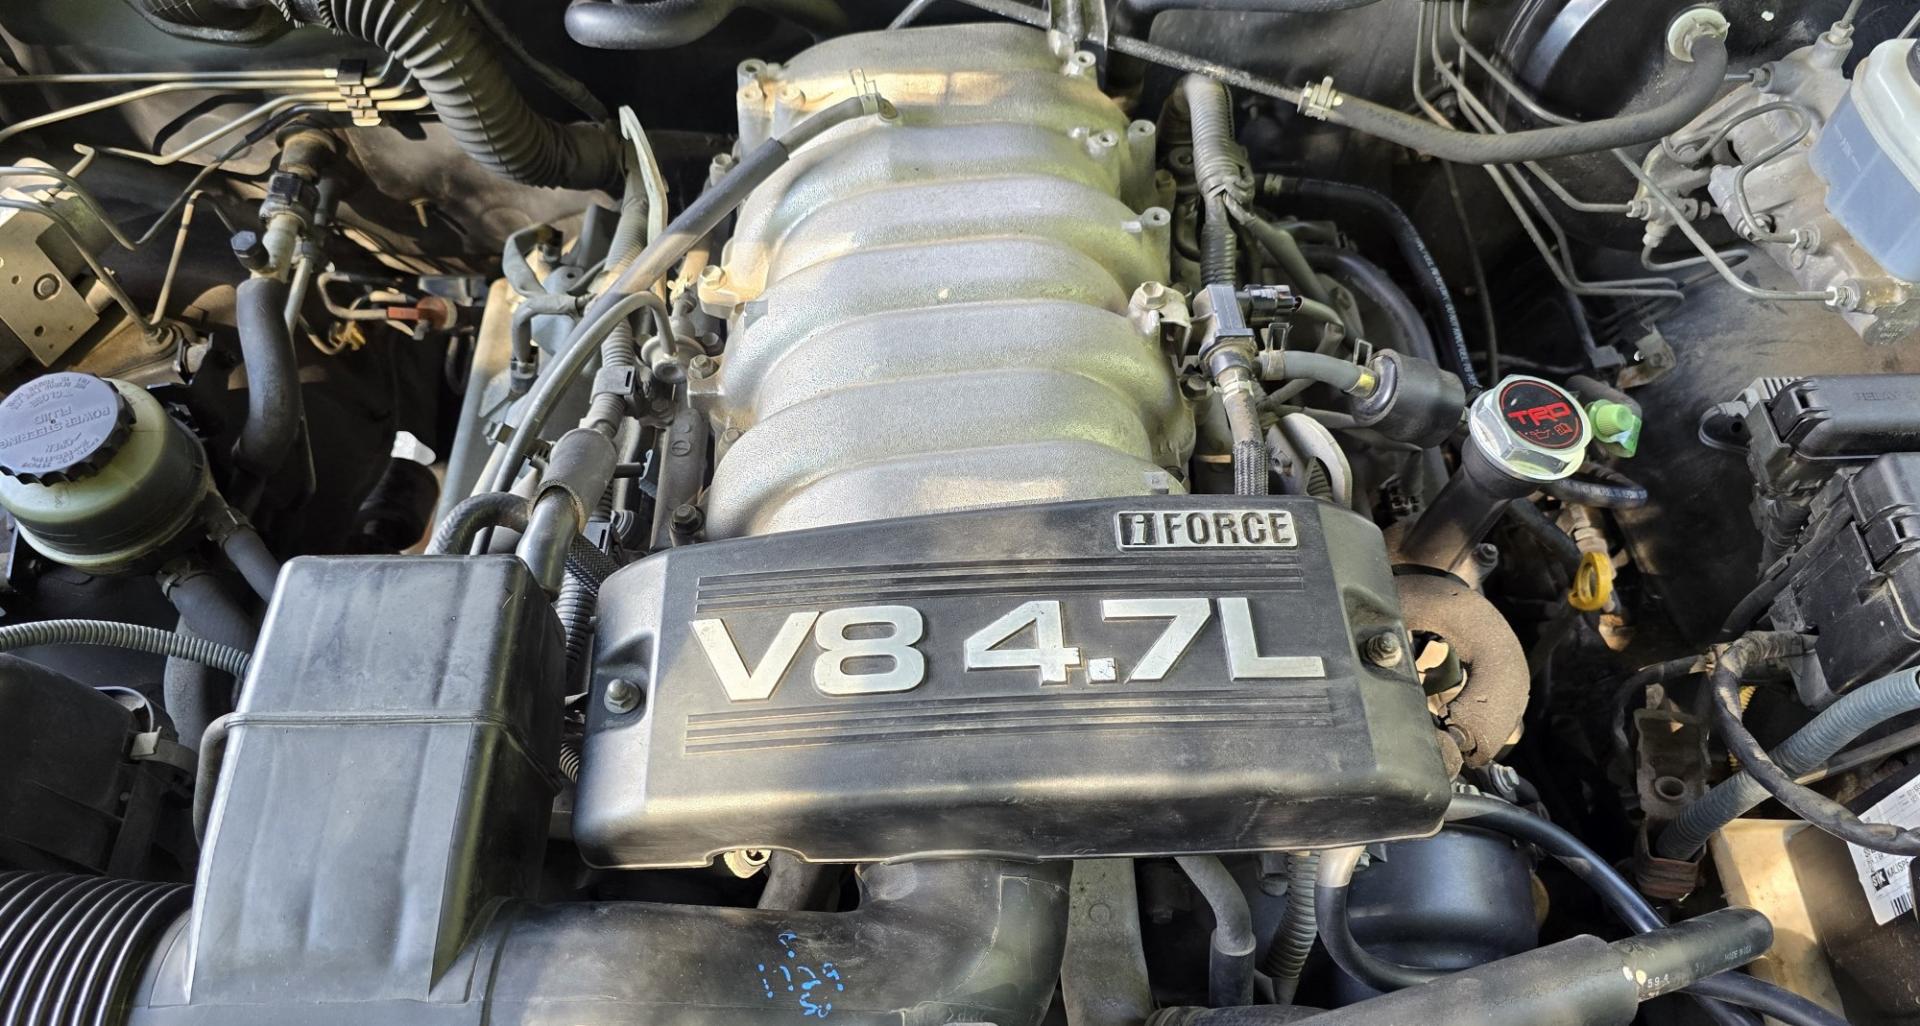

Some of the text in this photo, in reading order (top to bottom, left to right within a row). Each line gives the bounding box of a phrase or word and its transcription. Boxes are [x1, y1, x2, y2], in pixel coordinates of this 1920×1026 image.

[66, 406, 111, 429] POWER
[1507, 401, 1572, 426] TRD
[690, 596, 1327, 702] V8 4.7L
